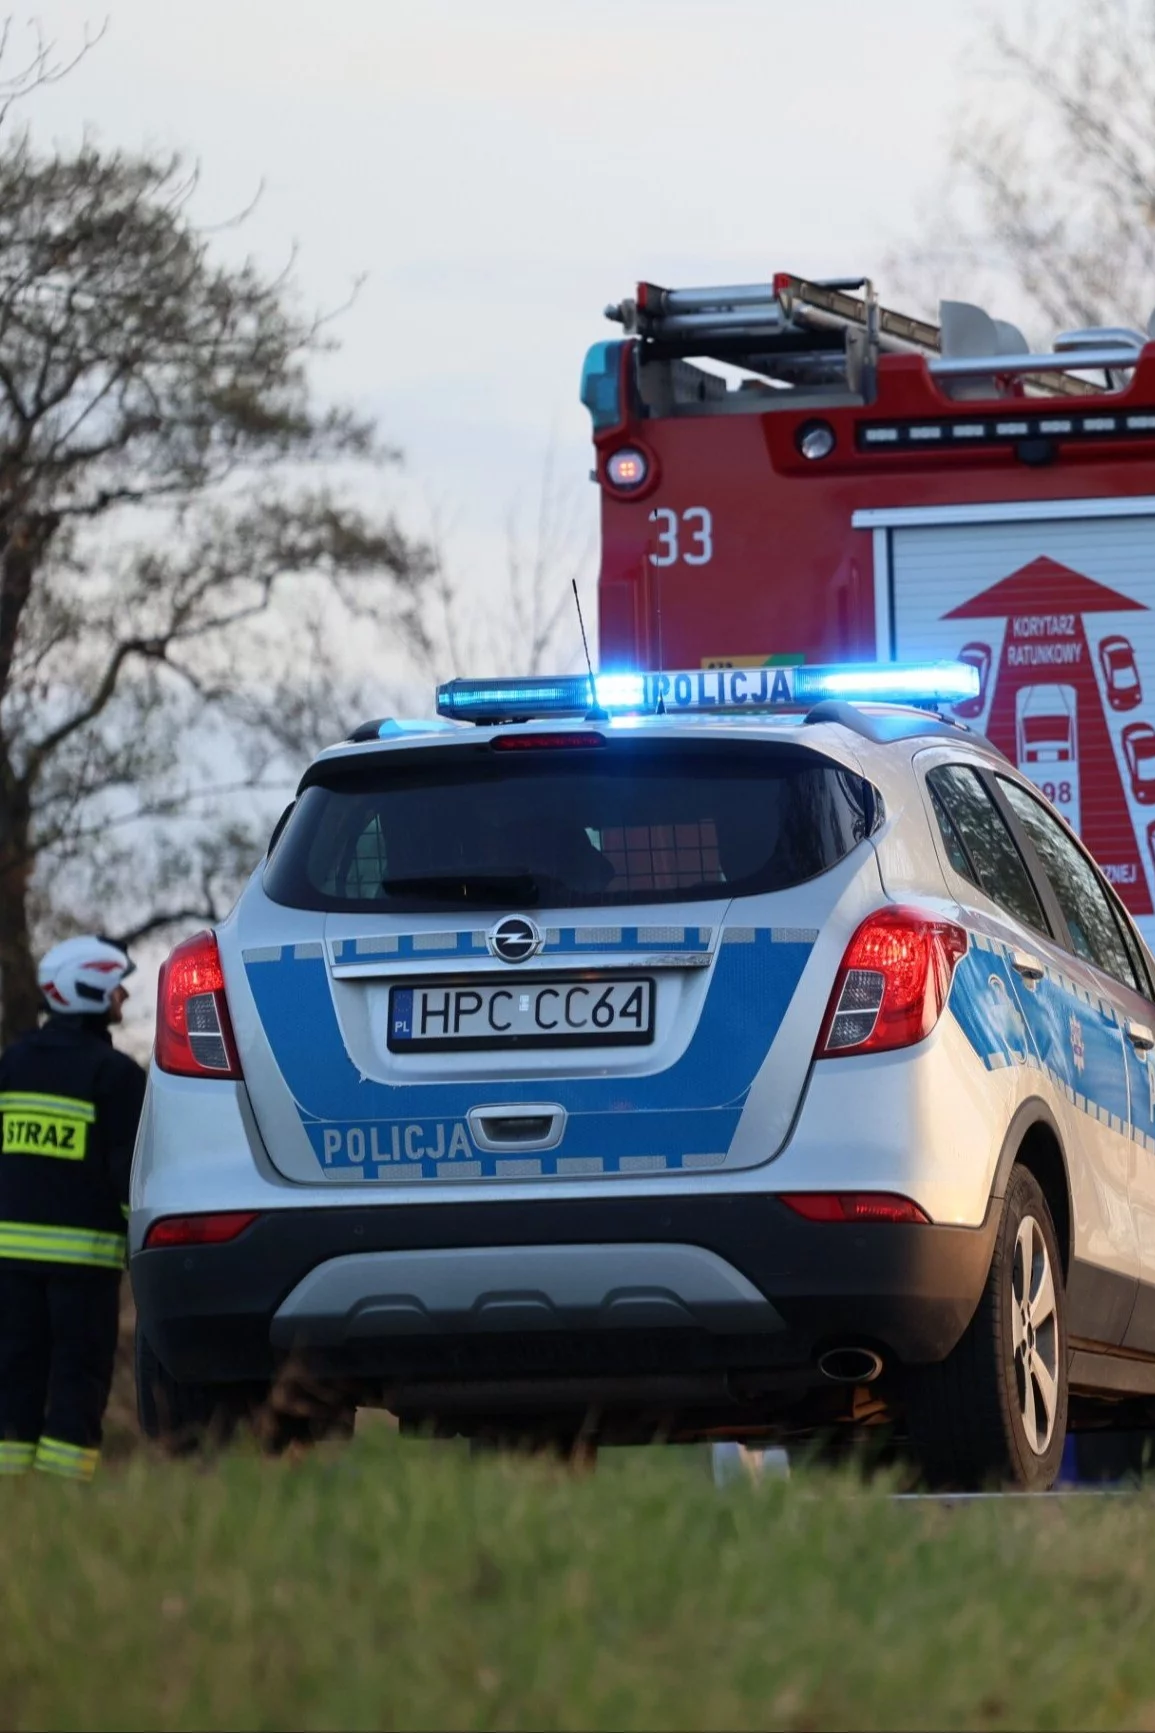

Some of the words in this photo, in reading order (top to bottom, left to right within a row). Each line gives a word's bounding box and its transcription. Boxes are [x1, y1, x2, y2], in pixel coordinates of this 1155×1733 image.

[648, 506, 712, 567] 33
[1013, 613, 1075, 637] KORYTARZ
[1008, 643, 1081, 667] RATUNKOWY
[652, 669, 792, 707] POLICJA
[395, 1021, 410, 1033] PL
[420, 990, 513, 1034] HPC
[535, 986, 643, 1030] CC64
[323, 1123, 473, 1164] POLICJA
